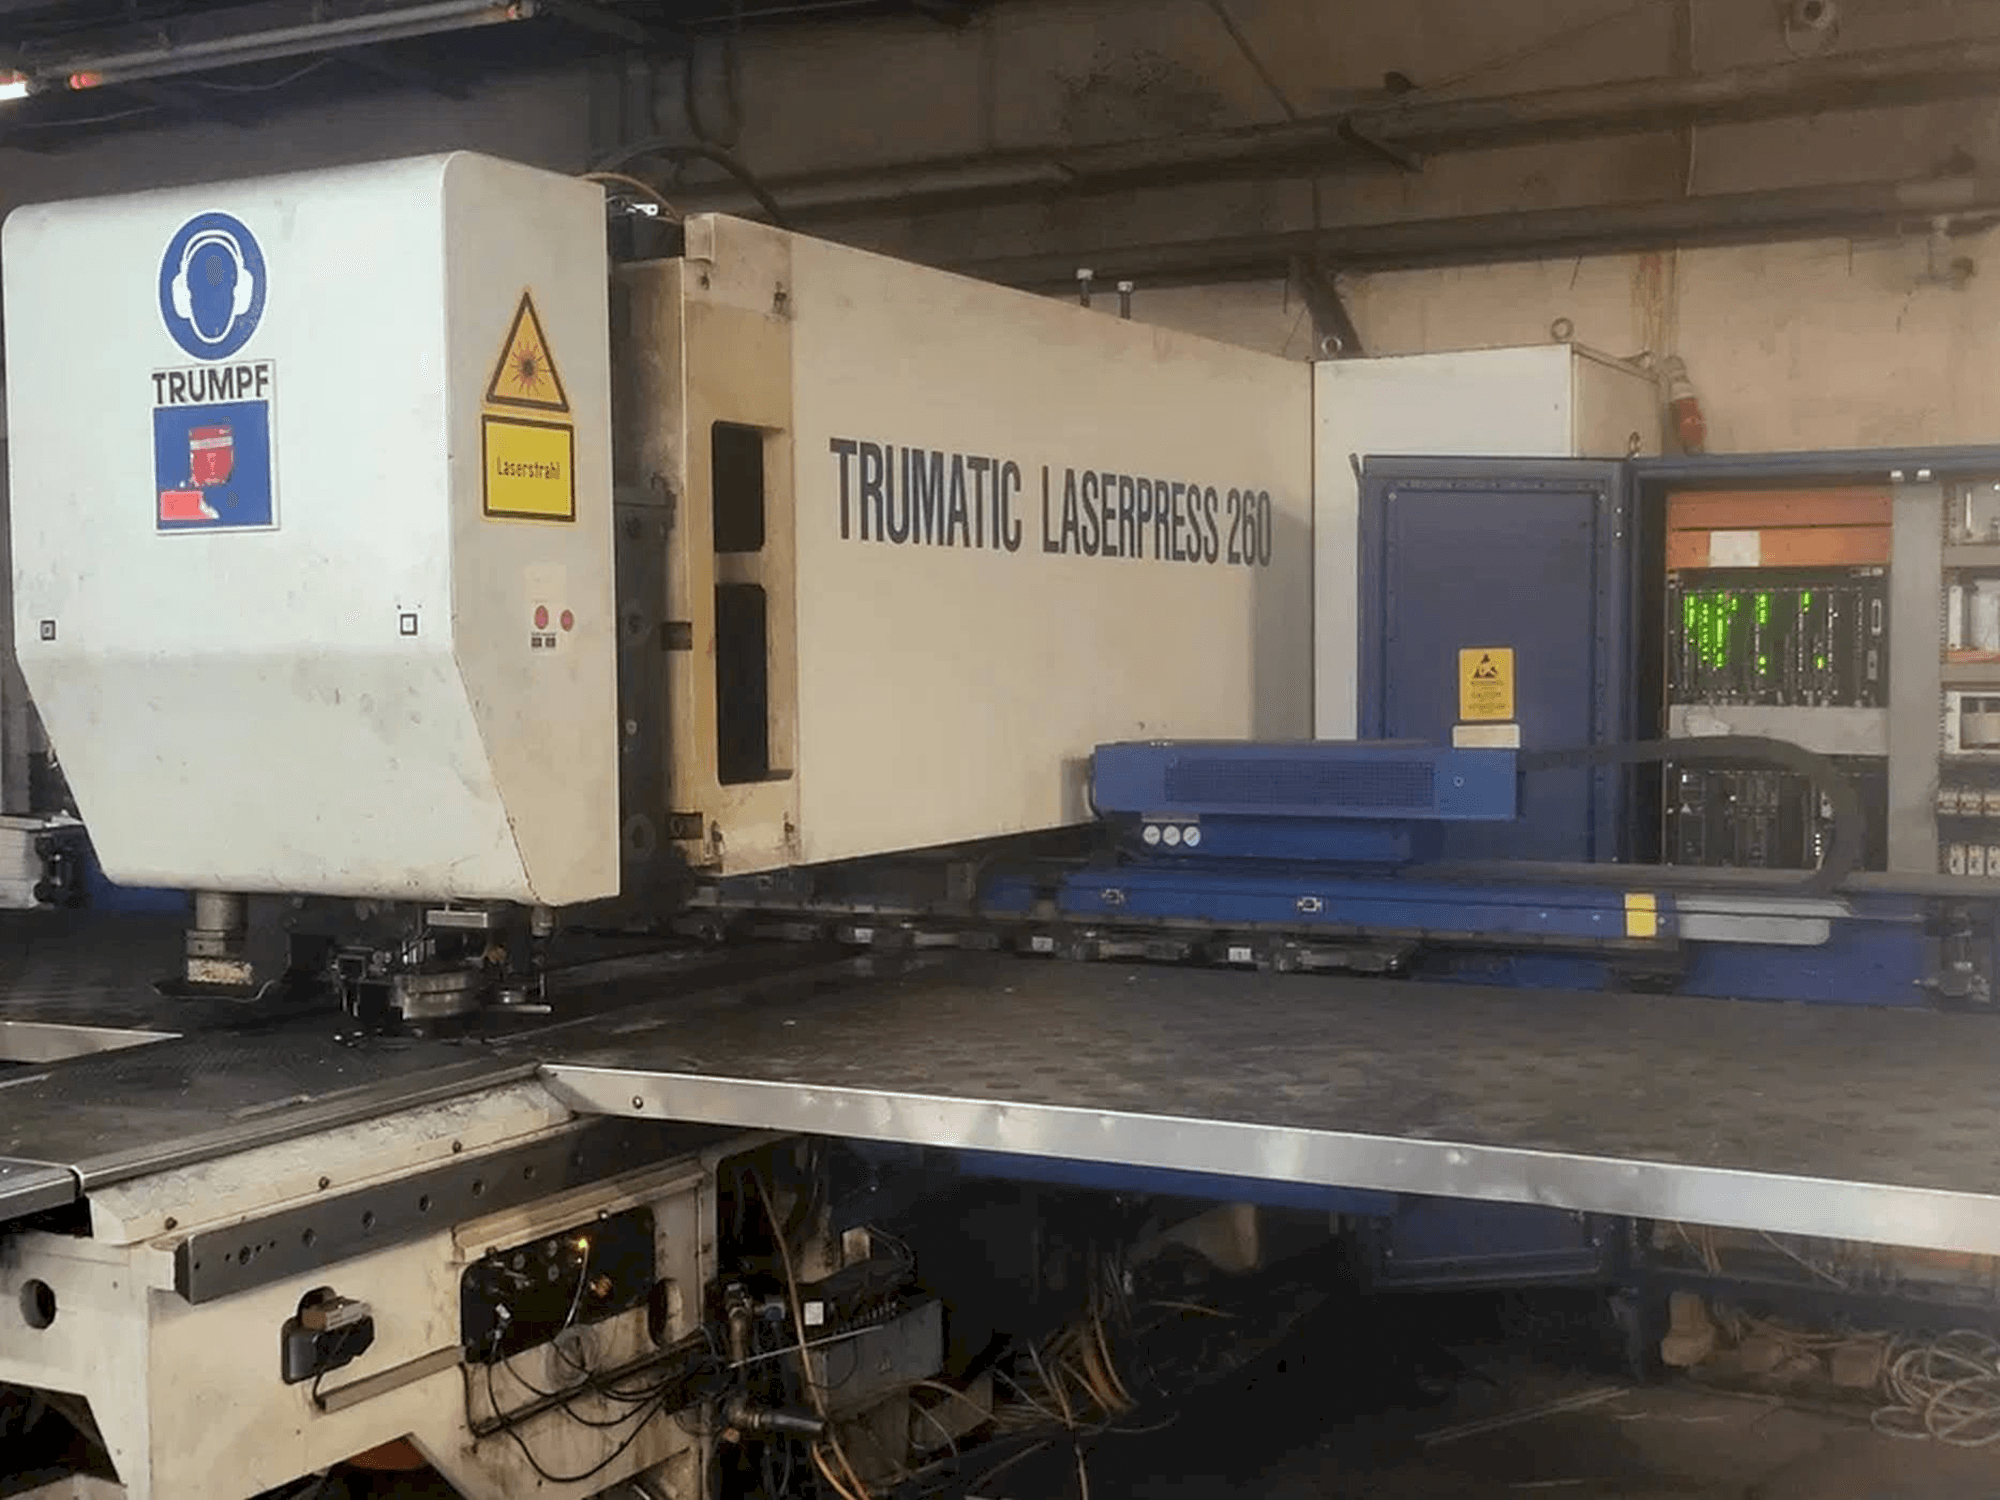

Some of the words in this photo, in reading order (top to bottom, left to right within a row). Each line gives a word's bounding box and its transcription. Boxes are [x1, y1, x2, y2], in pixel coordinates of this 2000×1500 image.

[152, 364, 269, 404] TRUMPF
[496, 456, 560, 480] Laserstrahl
[829, 437, 1022, 553] TRUMATIC
[1042, 465, 1219, 564] LASERPRESS
[1227, 487, 1272, 567] 260
